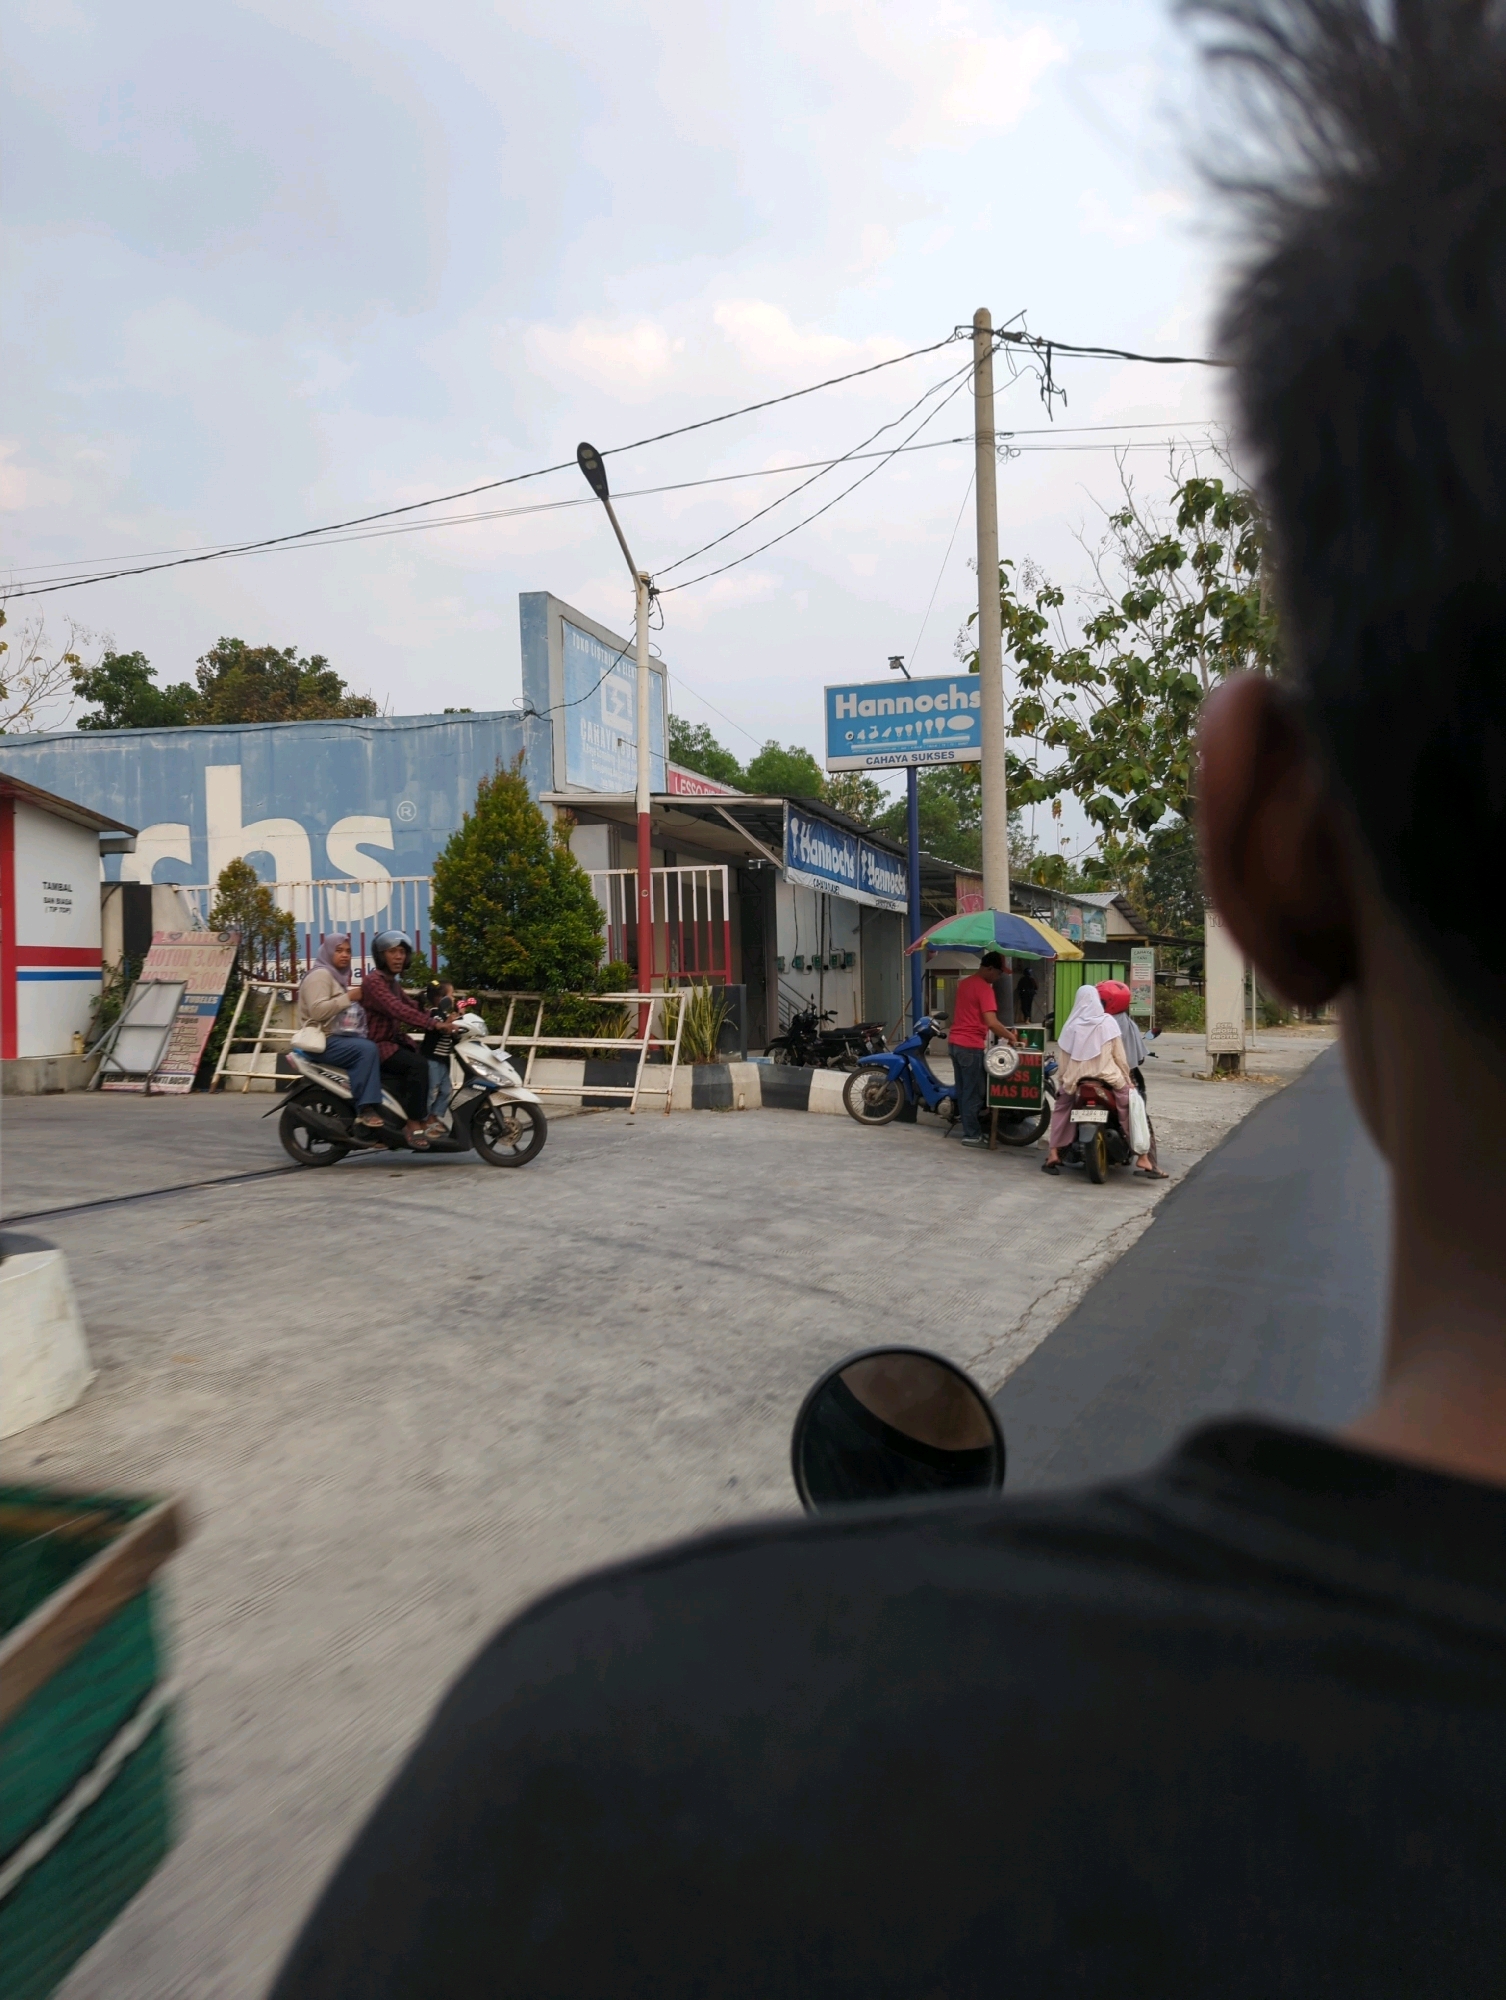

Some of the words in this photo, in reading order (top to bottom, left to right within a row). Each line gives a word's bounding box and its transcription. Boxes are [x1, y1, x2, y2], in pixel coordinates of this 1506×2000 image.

[835, 683, 980, 720] Hannochs
[580, 717, 617, 752] CAHAYA
[866, 754, 909, 765] CAHAYA
[911, 750, 955, 762] SUKSES
[800, 821, 855, 880] Hannochs
[42, 881, 73, 892] TAMBAL
[147, 948, 192, 967] MOTOR
[990, 1084, 1018, 1097] MAS
[1021, 1086, 1039, 1099] BG
